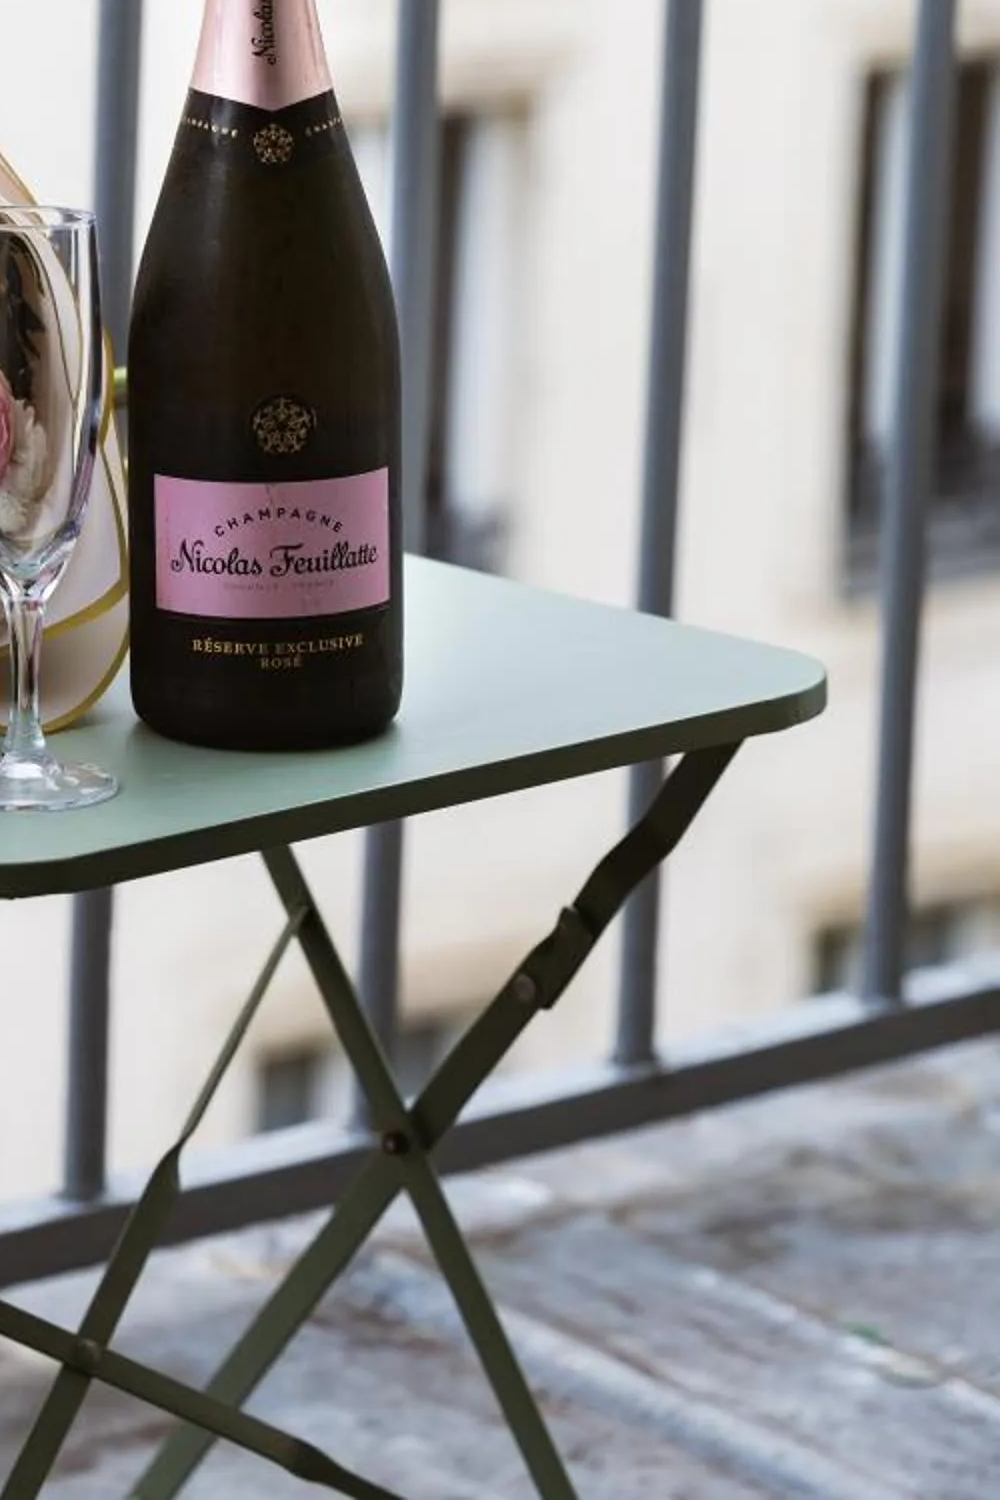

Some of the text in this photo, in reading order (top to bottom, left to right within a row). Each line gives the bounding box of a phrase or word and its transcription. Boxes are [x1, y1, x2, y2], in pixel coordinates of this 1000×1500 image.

[214, 506, 343, 537] CHAMPAGNE
[170, 538, 379, 577] Nicolas Feuillatte
[191, 632, 364, 655] RÉSERVE EXCLUSIVE
[260, 654, 303, 669] ROSÉ
